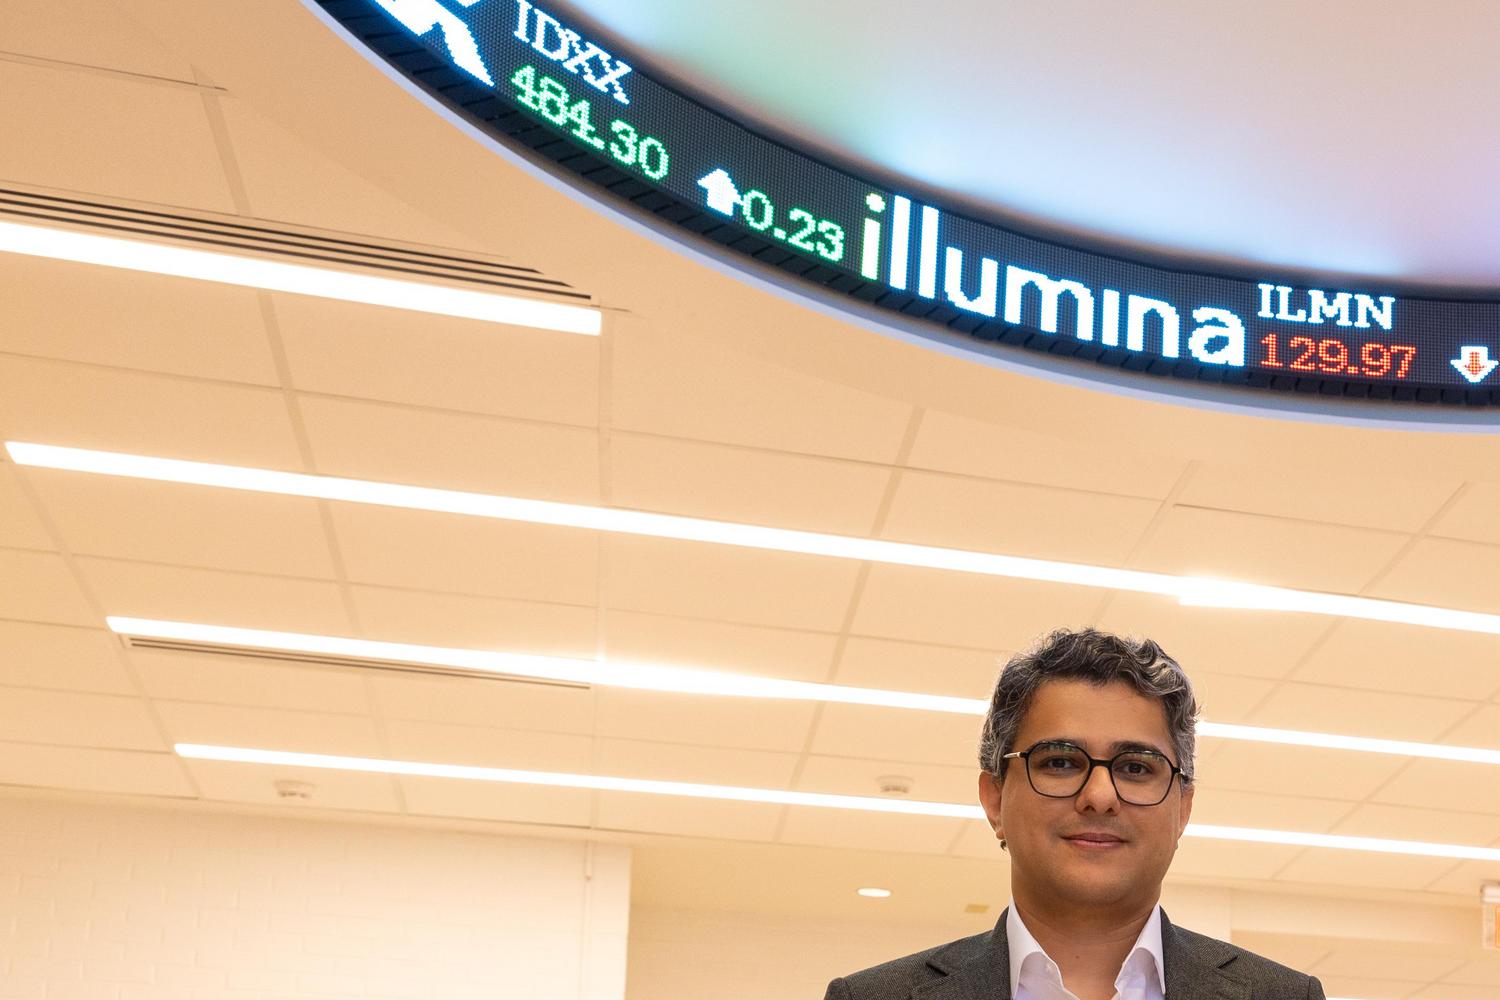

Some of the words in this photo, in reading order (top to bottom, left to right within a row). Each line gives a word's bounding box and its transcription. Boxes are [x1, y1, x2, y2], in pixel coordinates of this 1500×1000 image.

[512, 0, 633, 105] IDXX
[511, 65, 670, 180] 484.30
[742, 188, 846, 262] 0.23
[860, 193, 1247, 367] illumina
[1256, 282, 1396, 330] ILMN
[1258, 332, 1416, 379] 129.97
